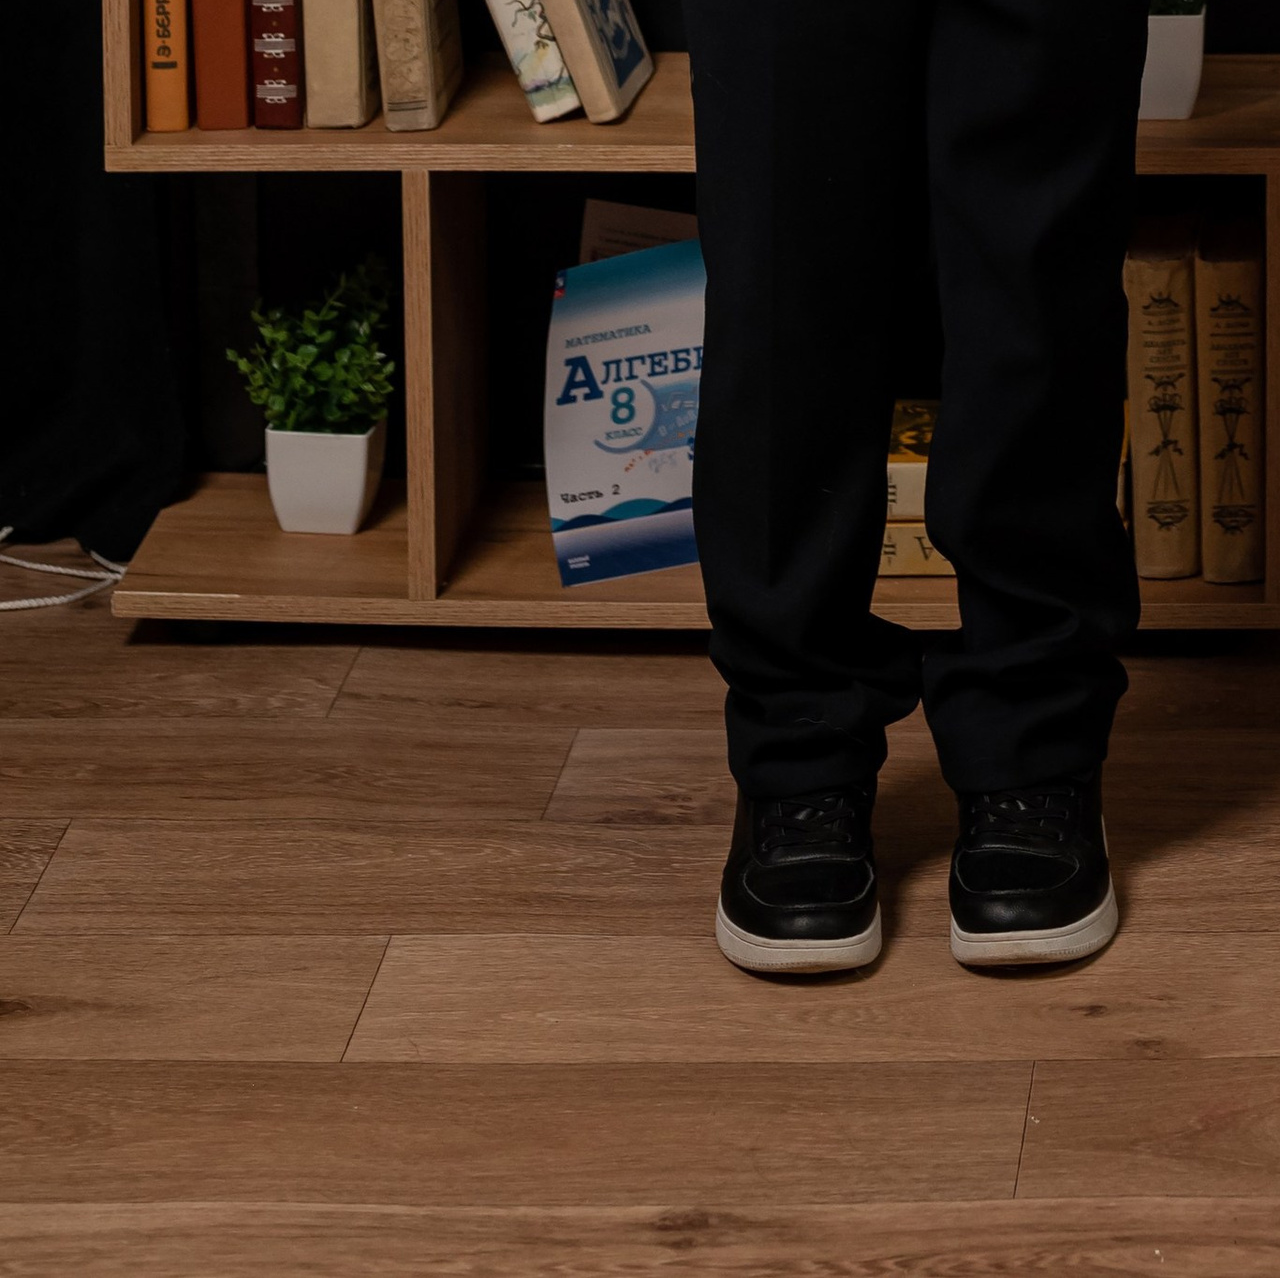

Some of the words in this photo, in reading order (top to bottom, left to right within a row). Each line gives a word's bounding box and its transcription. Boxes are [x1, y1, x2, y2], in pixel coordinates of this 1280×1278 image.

[565, 323, 653, 349] МАТЕМАТИКА
[610, 386, 636, 426] 8
[604, 426, 644, 442] КЛАСС
[560, 487, 604, 505] Часть
[611, 484, 621, 496] 2
